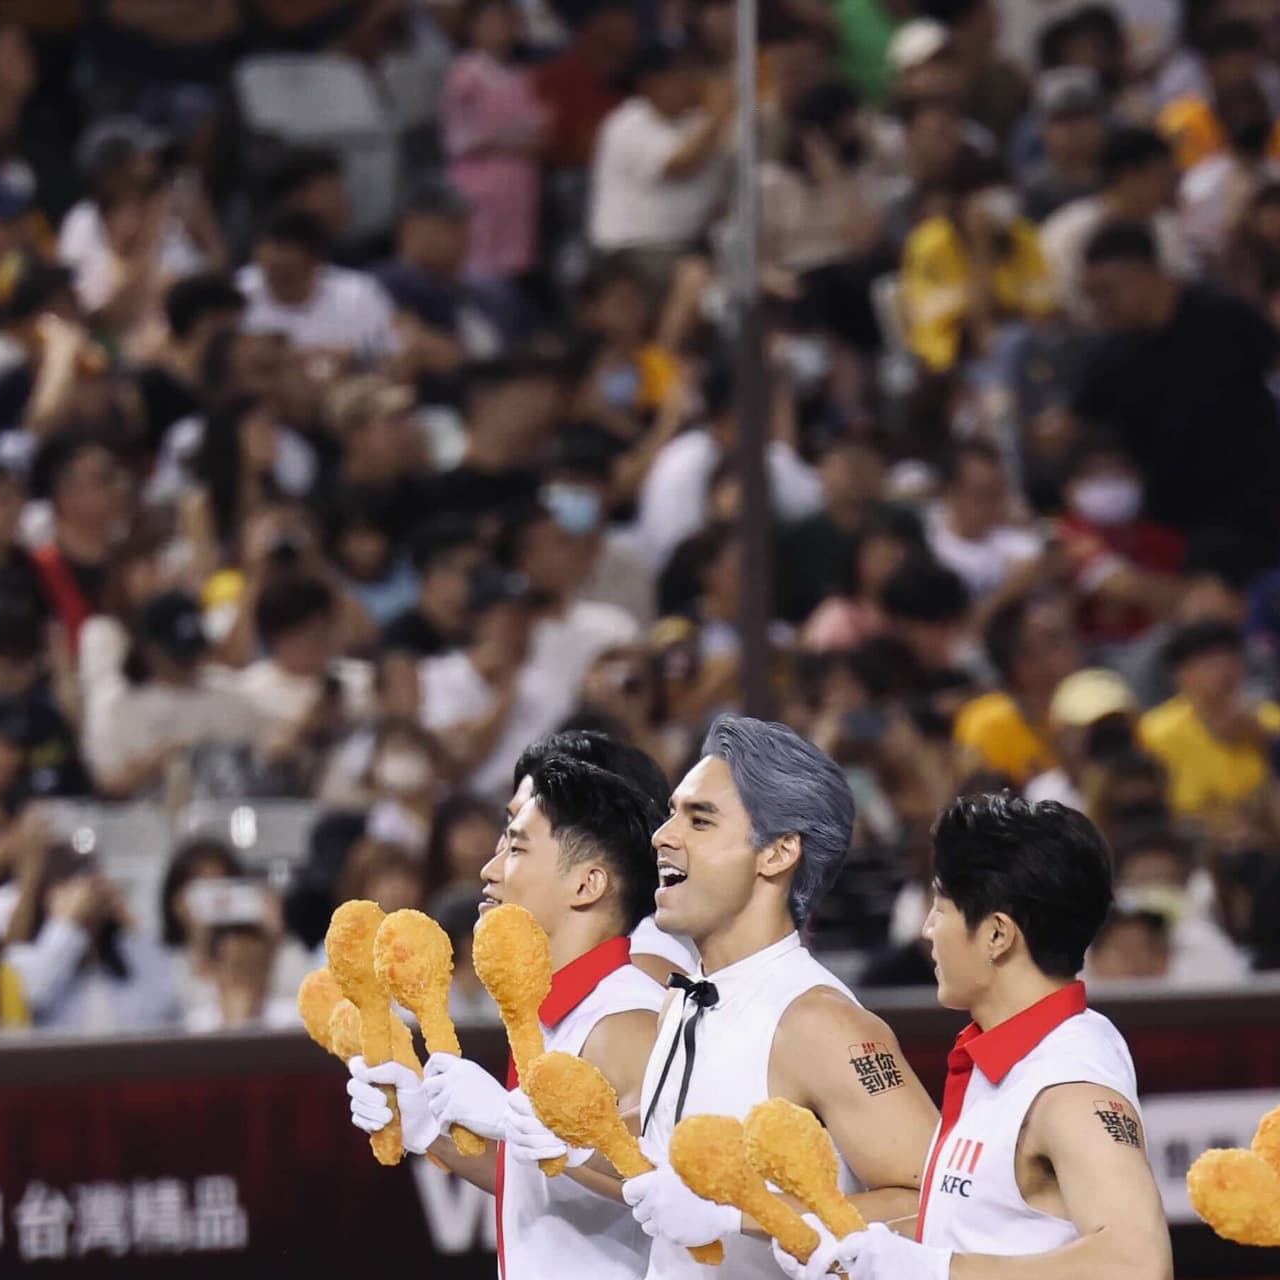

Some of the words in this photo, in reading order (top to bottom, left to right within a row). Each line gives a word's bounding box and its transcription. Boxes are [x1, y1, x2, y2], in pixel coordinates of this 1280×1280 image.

[940, 1174, 972, 1198] KFC
[13, 1174, 249, 1264] 台灣精品
